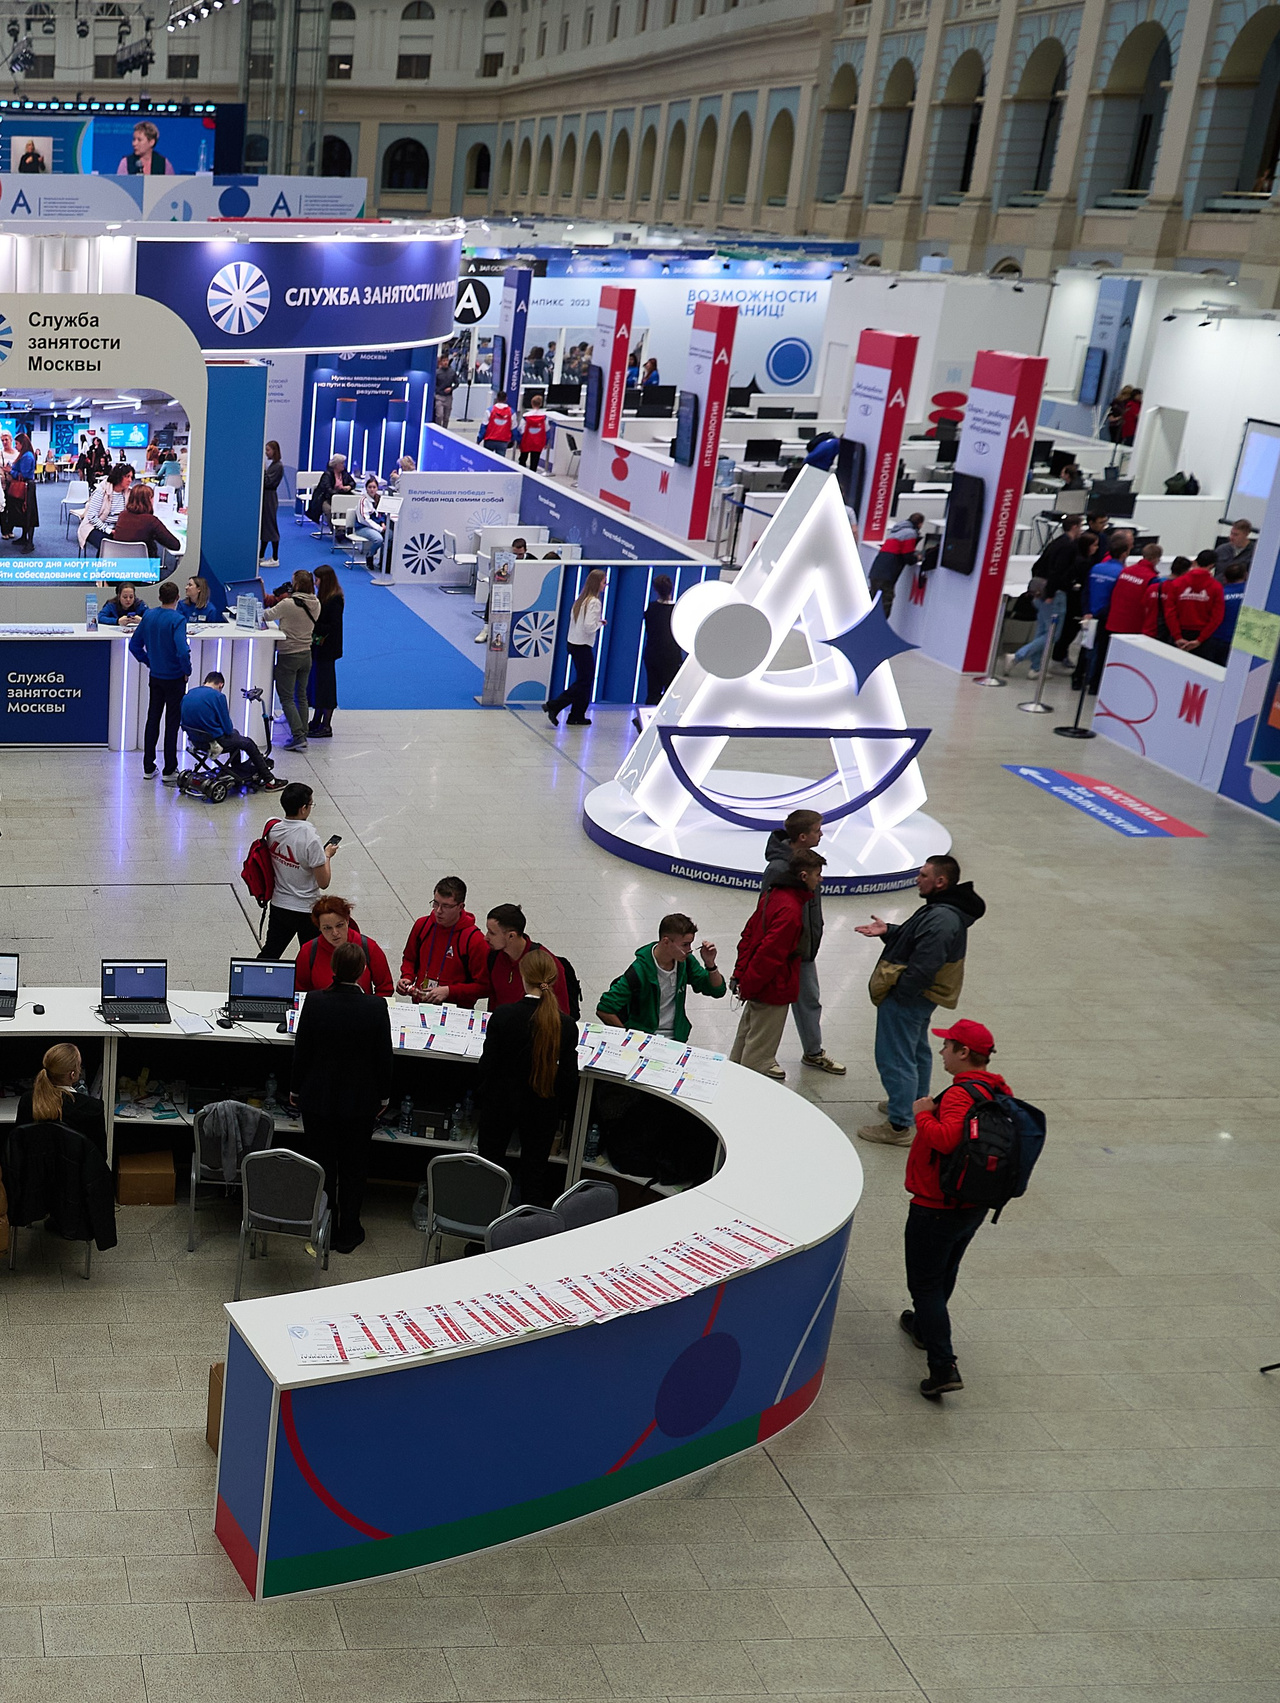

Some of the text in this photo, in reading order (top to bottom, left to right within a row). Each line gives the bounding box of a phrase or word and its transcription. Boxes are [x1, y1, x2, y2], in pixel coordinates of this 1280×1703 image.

[285, 287, 360, 307] СЛУЖБА
[363, 284, 433, 305] ЗАНЯТОСТИ
[688, 290, 817, 303] ВОЗМОЖНОСТИ
[28, 311, 99, 331] Служба
[28, 337, 120, 350] занятости
[28, 356, 101, 371] Москвы
[872, 452, 893, 531] IT-ТЕХНОЛОГИИ
[988, 488, 1014, 576] IT-ТЕХНОЛОГИИ
[12, 561, 44, 569] одного
[64, 561, 90, 569] могут
[91, 559, 117, 568] найти
[12, 570, 81, 580] собеседование
[90, 570, 159, 580] работодателем.
[7, 671, 65, 686] Служба
[7, 687, 82, 698] занятости
[7, 701, 65, 713] Москвы
[671, 864, 762, 890] НАЦИОНАЛЬНЫ
[849, 878, 918, 894] «АБИЛИМПИКС
